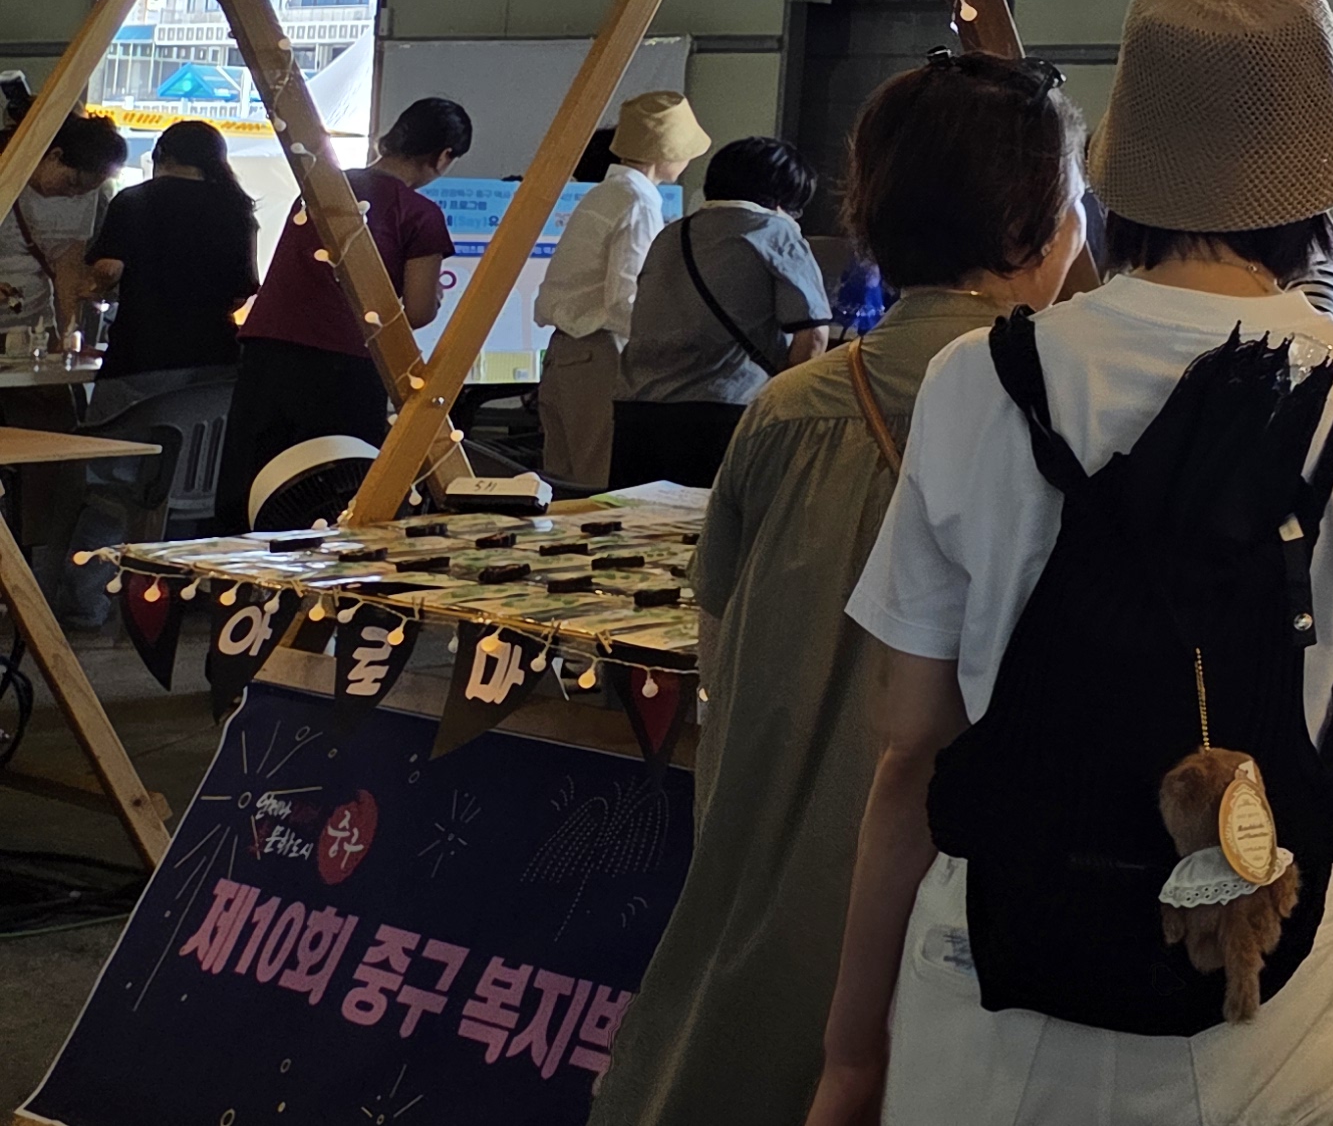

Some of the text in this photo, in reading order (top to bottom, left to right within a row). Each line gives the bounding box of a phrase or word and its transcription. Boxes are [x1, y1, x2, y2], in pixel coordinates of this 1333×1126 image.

[464, 637, 526, 705] 마
[326, 809, 365, 860] 중구
[179, 877, 359, 1006] 제10회
[341, 922, 471, 1039] 중구
